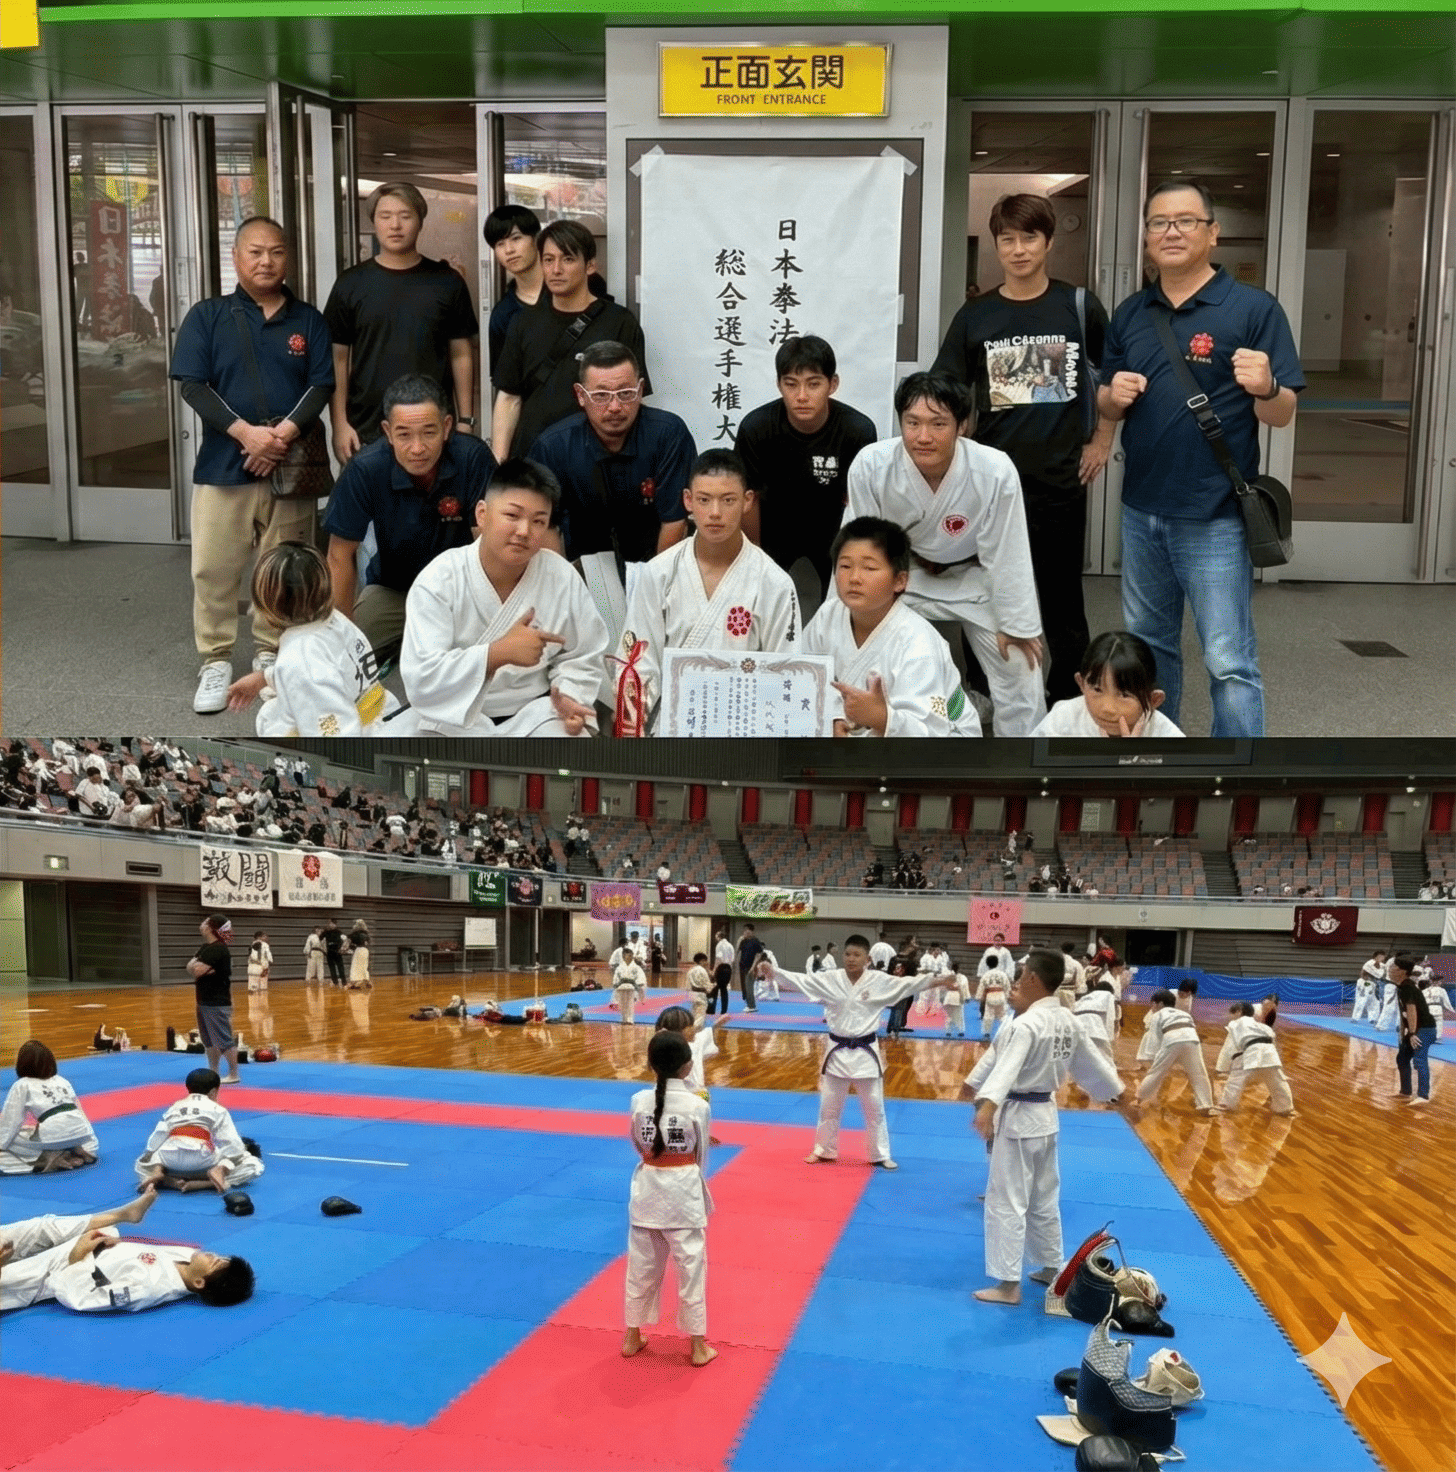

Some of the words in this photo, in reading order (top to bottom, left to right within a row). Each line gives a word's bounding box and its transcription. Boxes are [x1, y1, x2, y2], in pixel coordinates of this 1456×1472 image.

[700, 55, 844, 89] 正面玄関
[717, 94, 756, 104] FRONT
[763, 94, 827, 105] ENTRANCE
[769, 219, 804, 345] 日本拳法
[711, 248, 748, 442] 総合選手権大
